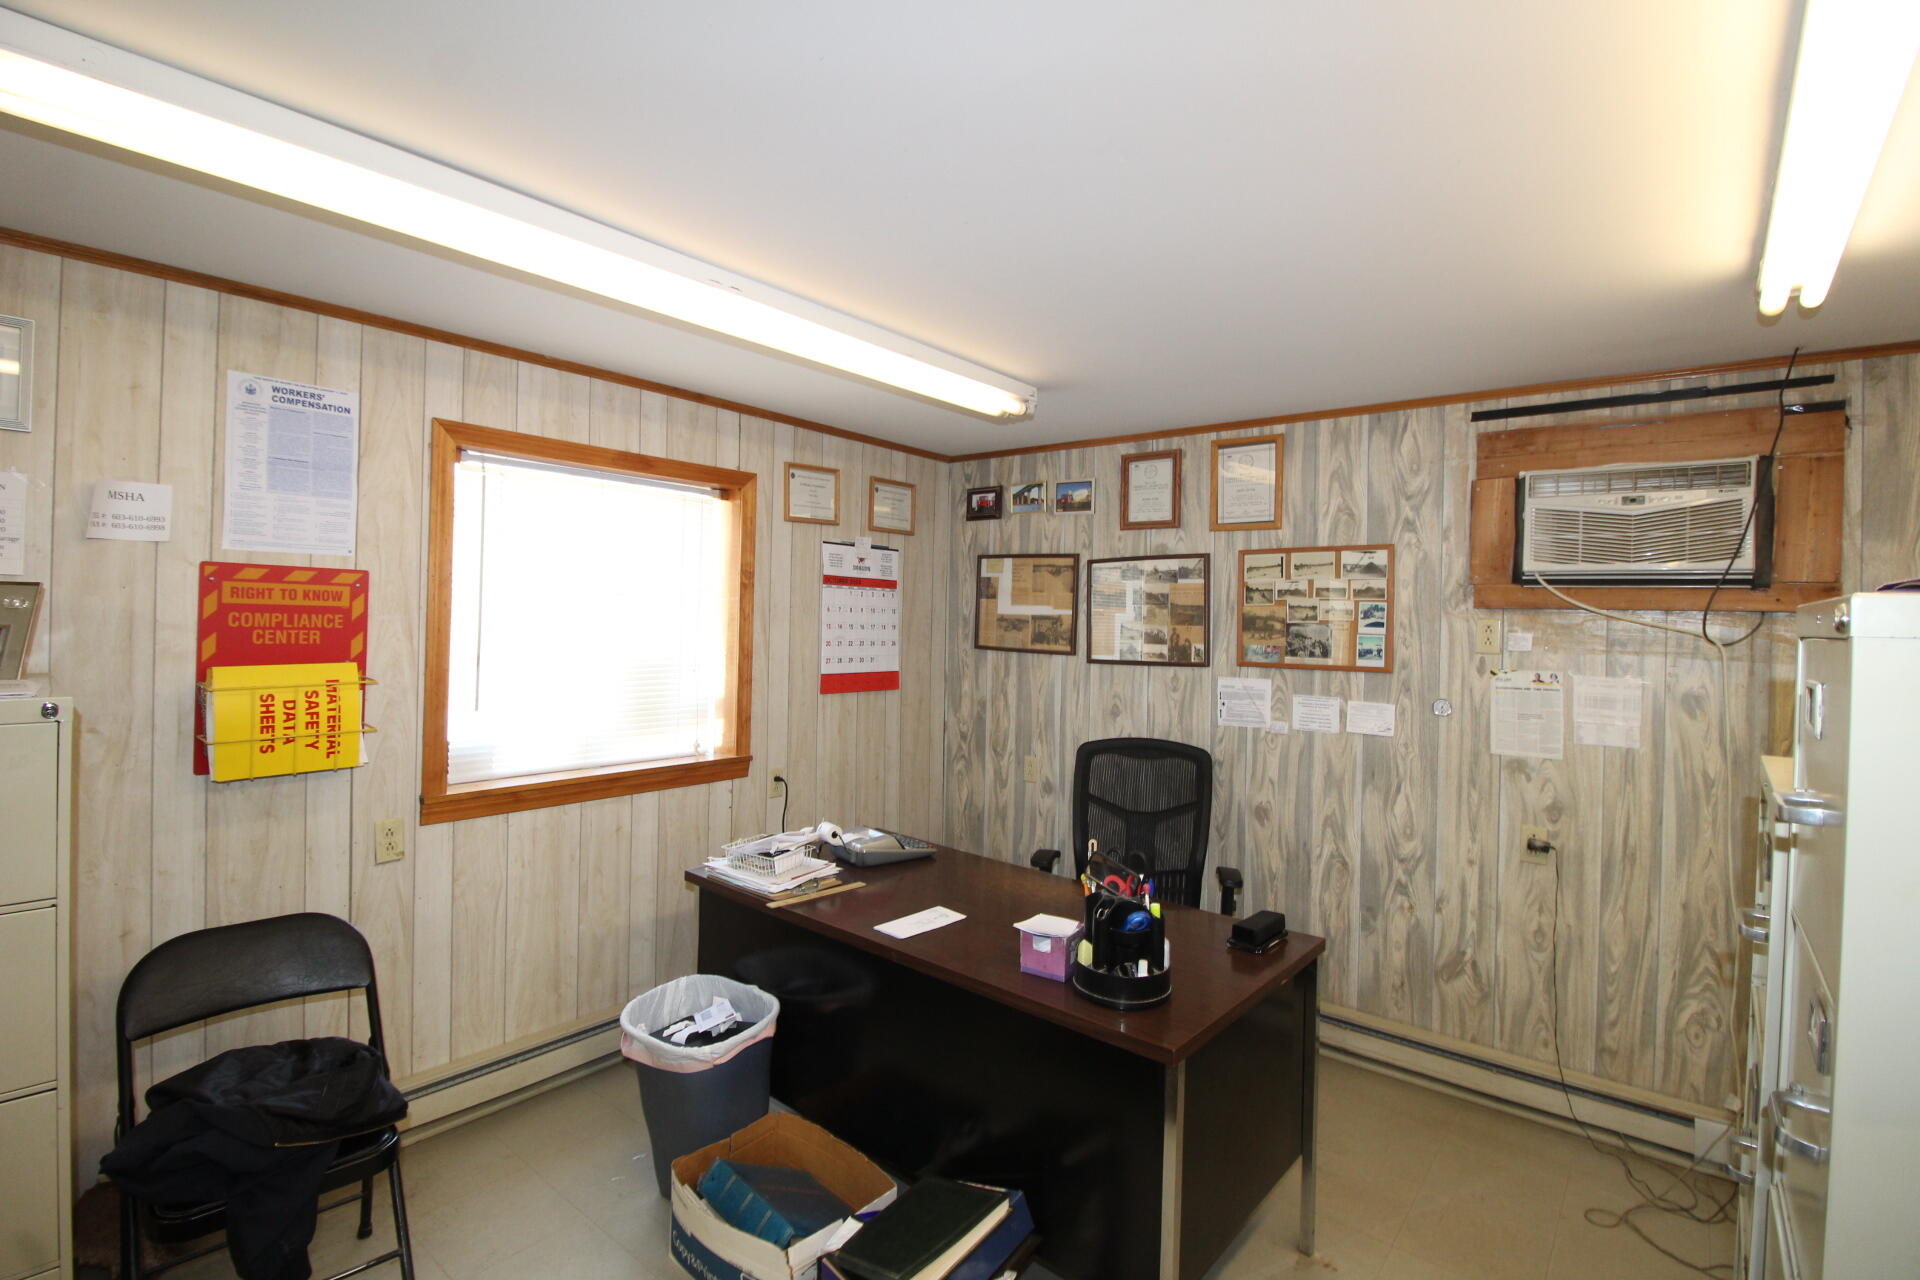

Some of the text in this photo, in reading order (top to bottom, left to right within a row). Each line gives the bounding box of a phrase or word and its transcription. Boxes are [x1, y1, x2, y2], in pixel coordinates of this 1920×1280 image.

[271, 385, 326, 401] WORKERS'
[271, 395, 351, 415] COMPENSATION
[107, 489, 145, 502] MSHA
[230, 586, 344, 602] RIGHT TO KNOW
[228, 611, 344, 628] COMPLIANCE
[252, 629, 321, 645] CENTER
[259, 693, 276, 754] SHEETS
[282, 700, 297, 745] DATA
[304, 690, 320, 750] SAFETY
